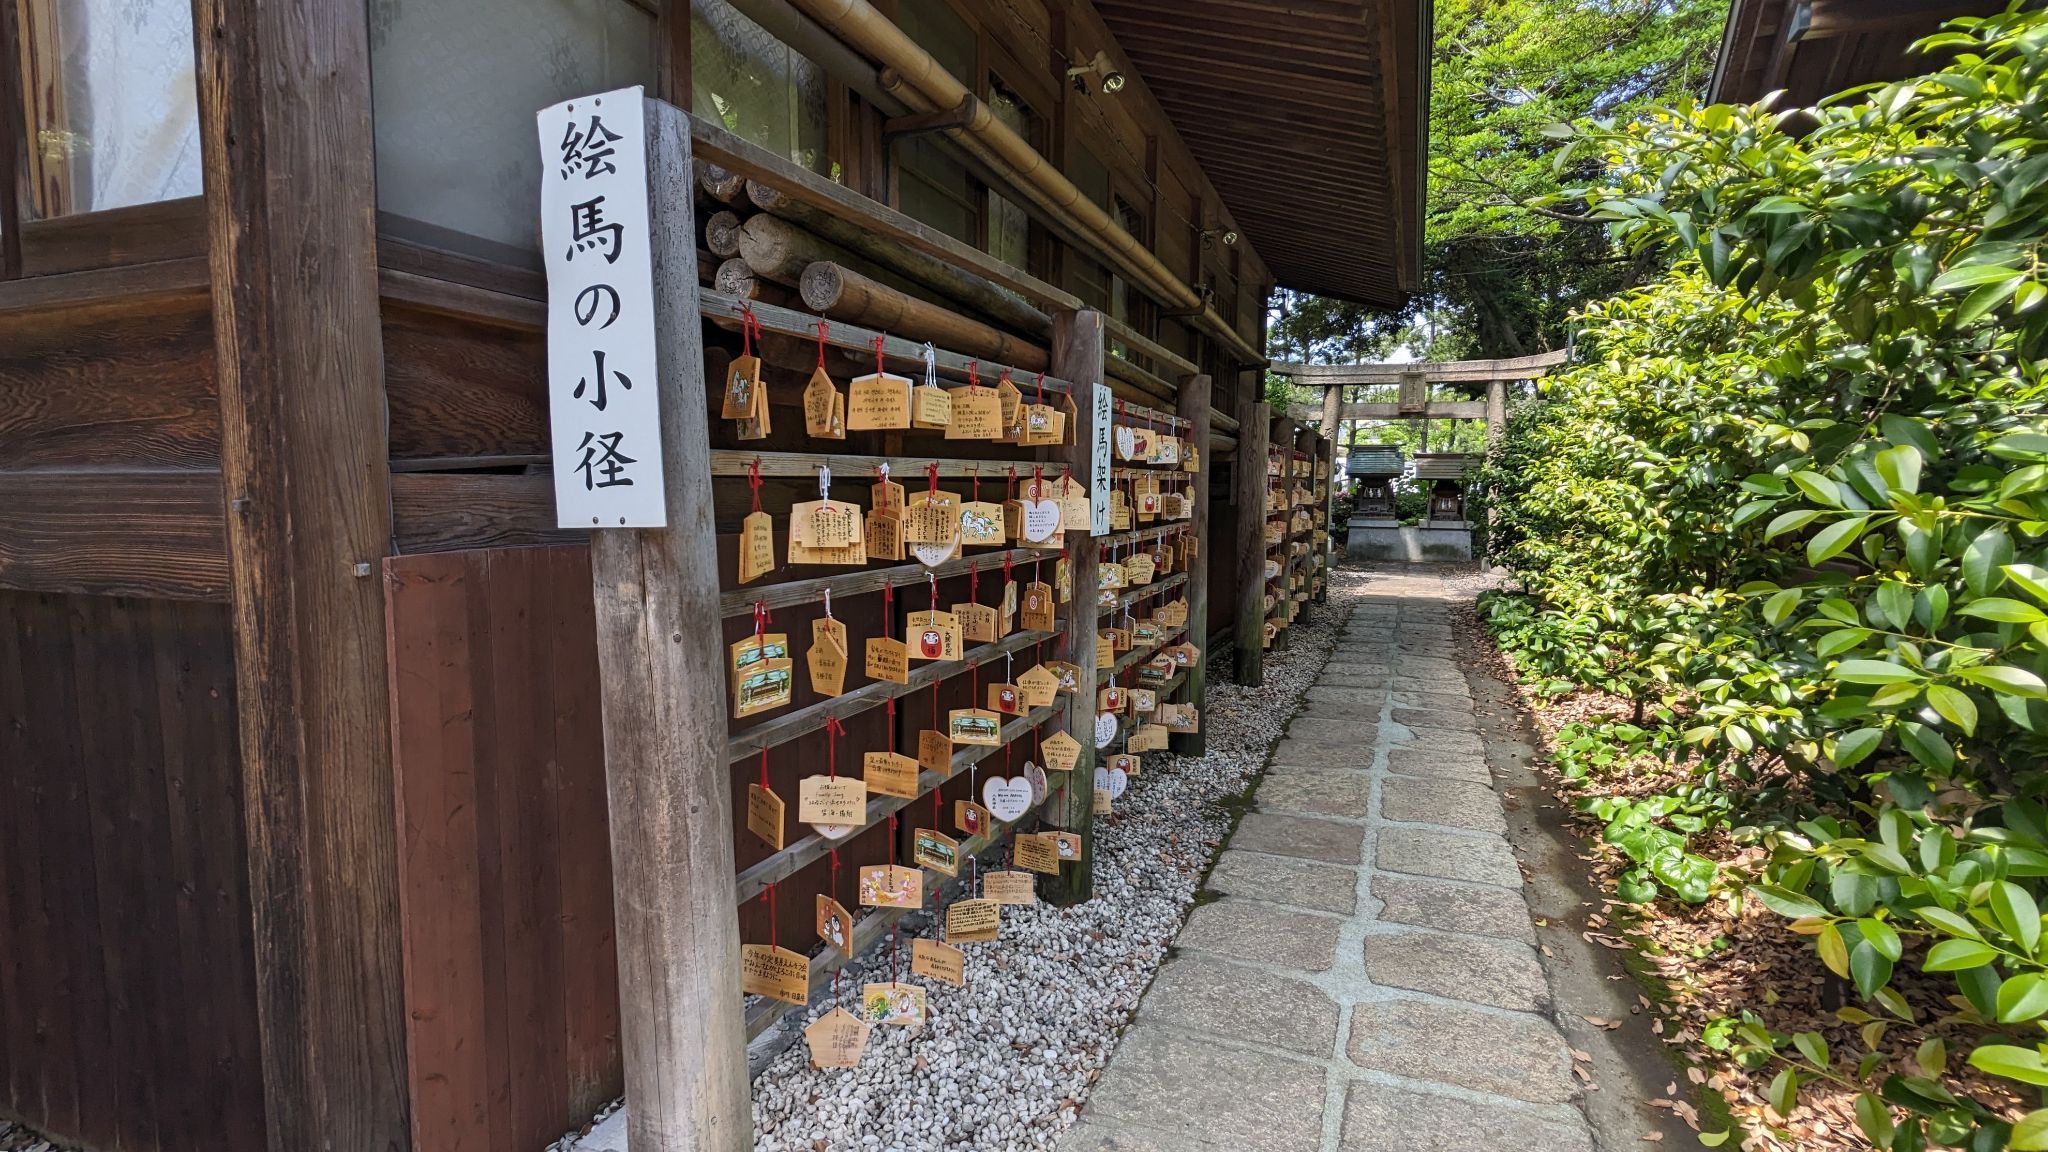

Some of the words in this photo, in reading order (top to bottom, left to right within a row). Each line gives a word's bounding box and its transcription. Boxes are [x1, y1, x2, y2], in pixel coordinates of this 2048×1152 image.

[560, 115, 638, 491] 絵馬の小径
[1096, 392, 1109, 526] 絵馬架け
